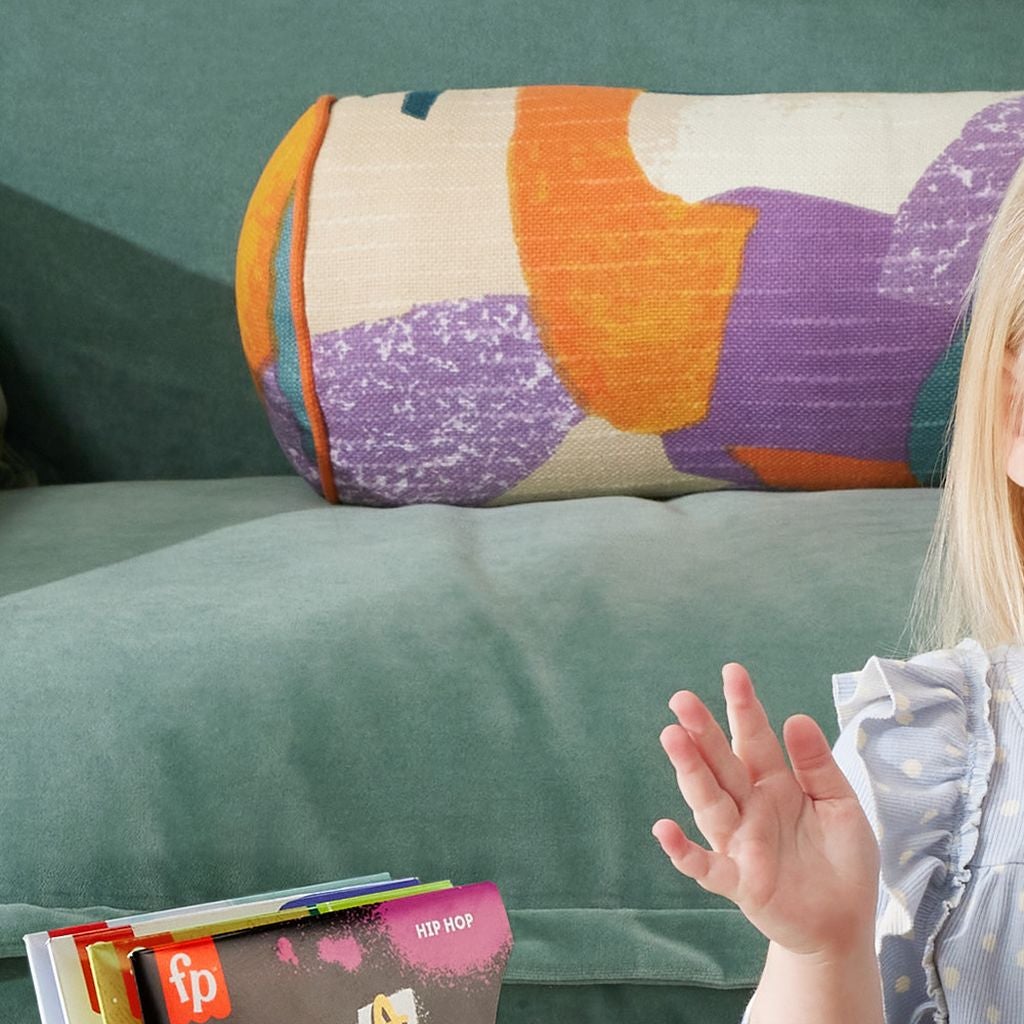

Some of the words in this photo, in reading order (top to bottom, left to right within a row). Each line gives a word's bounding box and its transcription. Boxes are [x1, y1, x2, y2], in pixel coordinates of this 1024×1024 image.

[415, 917, 442, 939] HIP
[444, 913, 475, 934] HOP
[168, 952, 218, 1014] fp
